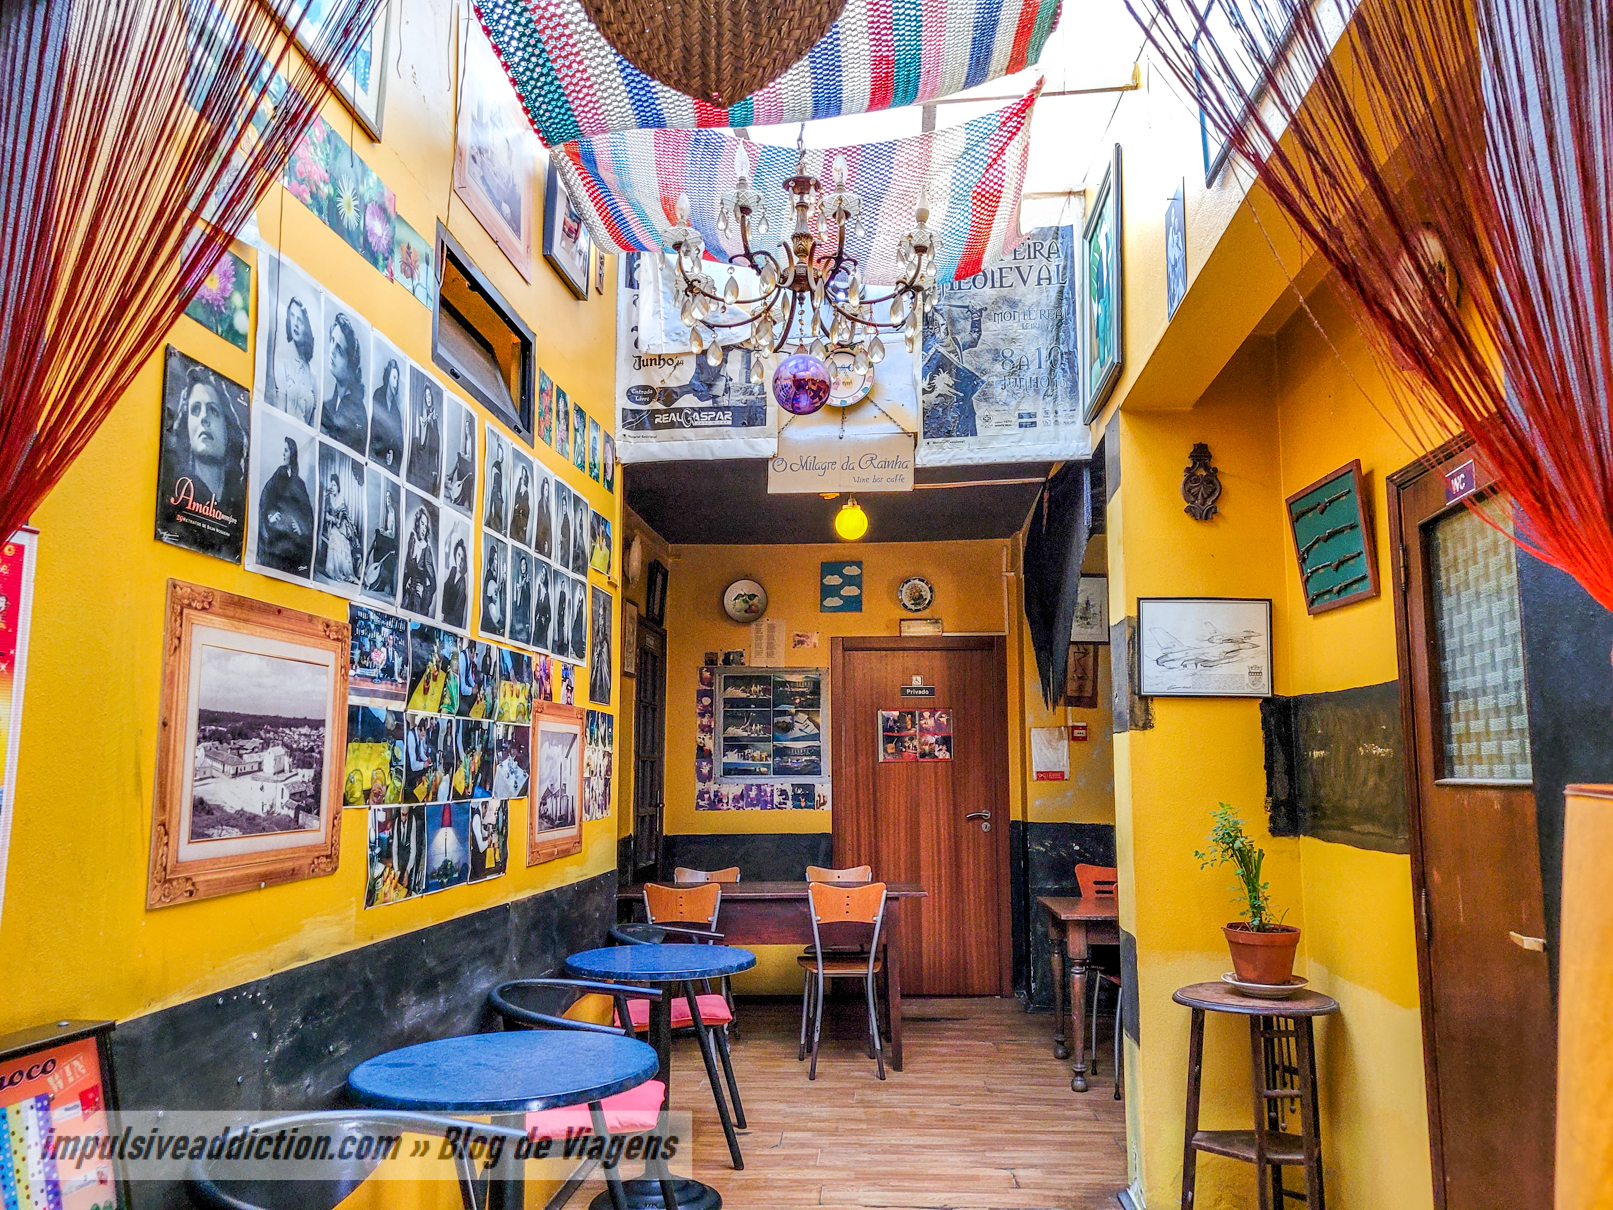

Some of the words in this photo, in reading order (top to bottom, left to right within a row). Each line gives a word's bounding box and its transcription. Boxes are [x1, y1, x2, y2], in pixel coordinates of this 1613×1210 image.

[1001, 347, 1015, 371] 8
[1018, 354, 1031, 371] A
[1035, 345, 1064, 370] 10
[772, 457, 788, 473] O
[789, 455, 838, 477] Milagre
[841, 456, 856, 471] da
[858, 453, 911, 471] Rainha
[852, 475, 870, 484] Wine
[872, 474, 884, 484] bar
[1451, 473, 1466, 495] WC
[46, 1056, 87, 1093] WIN
